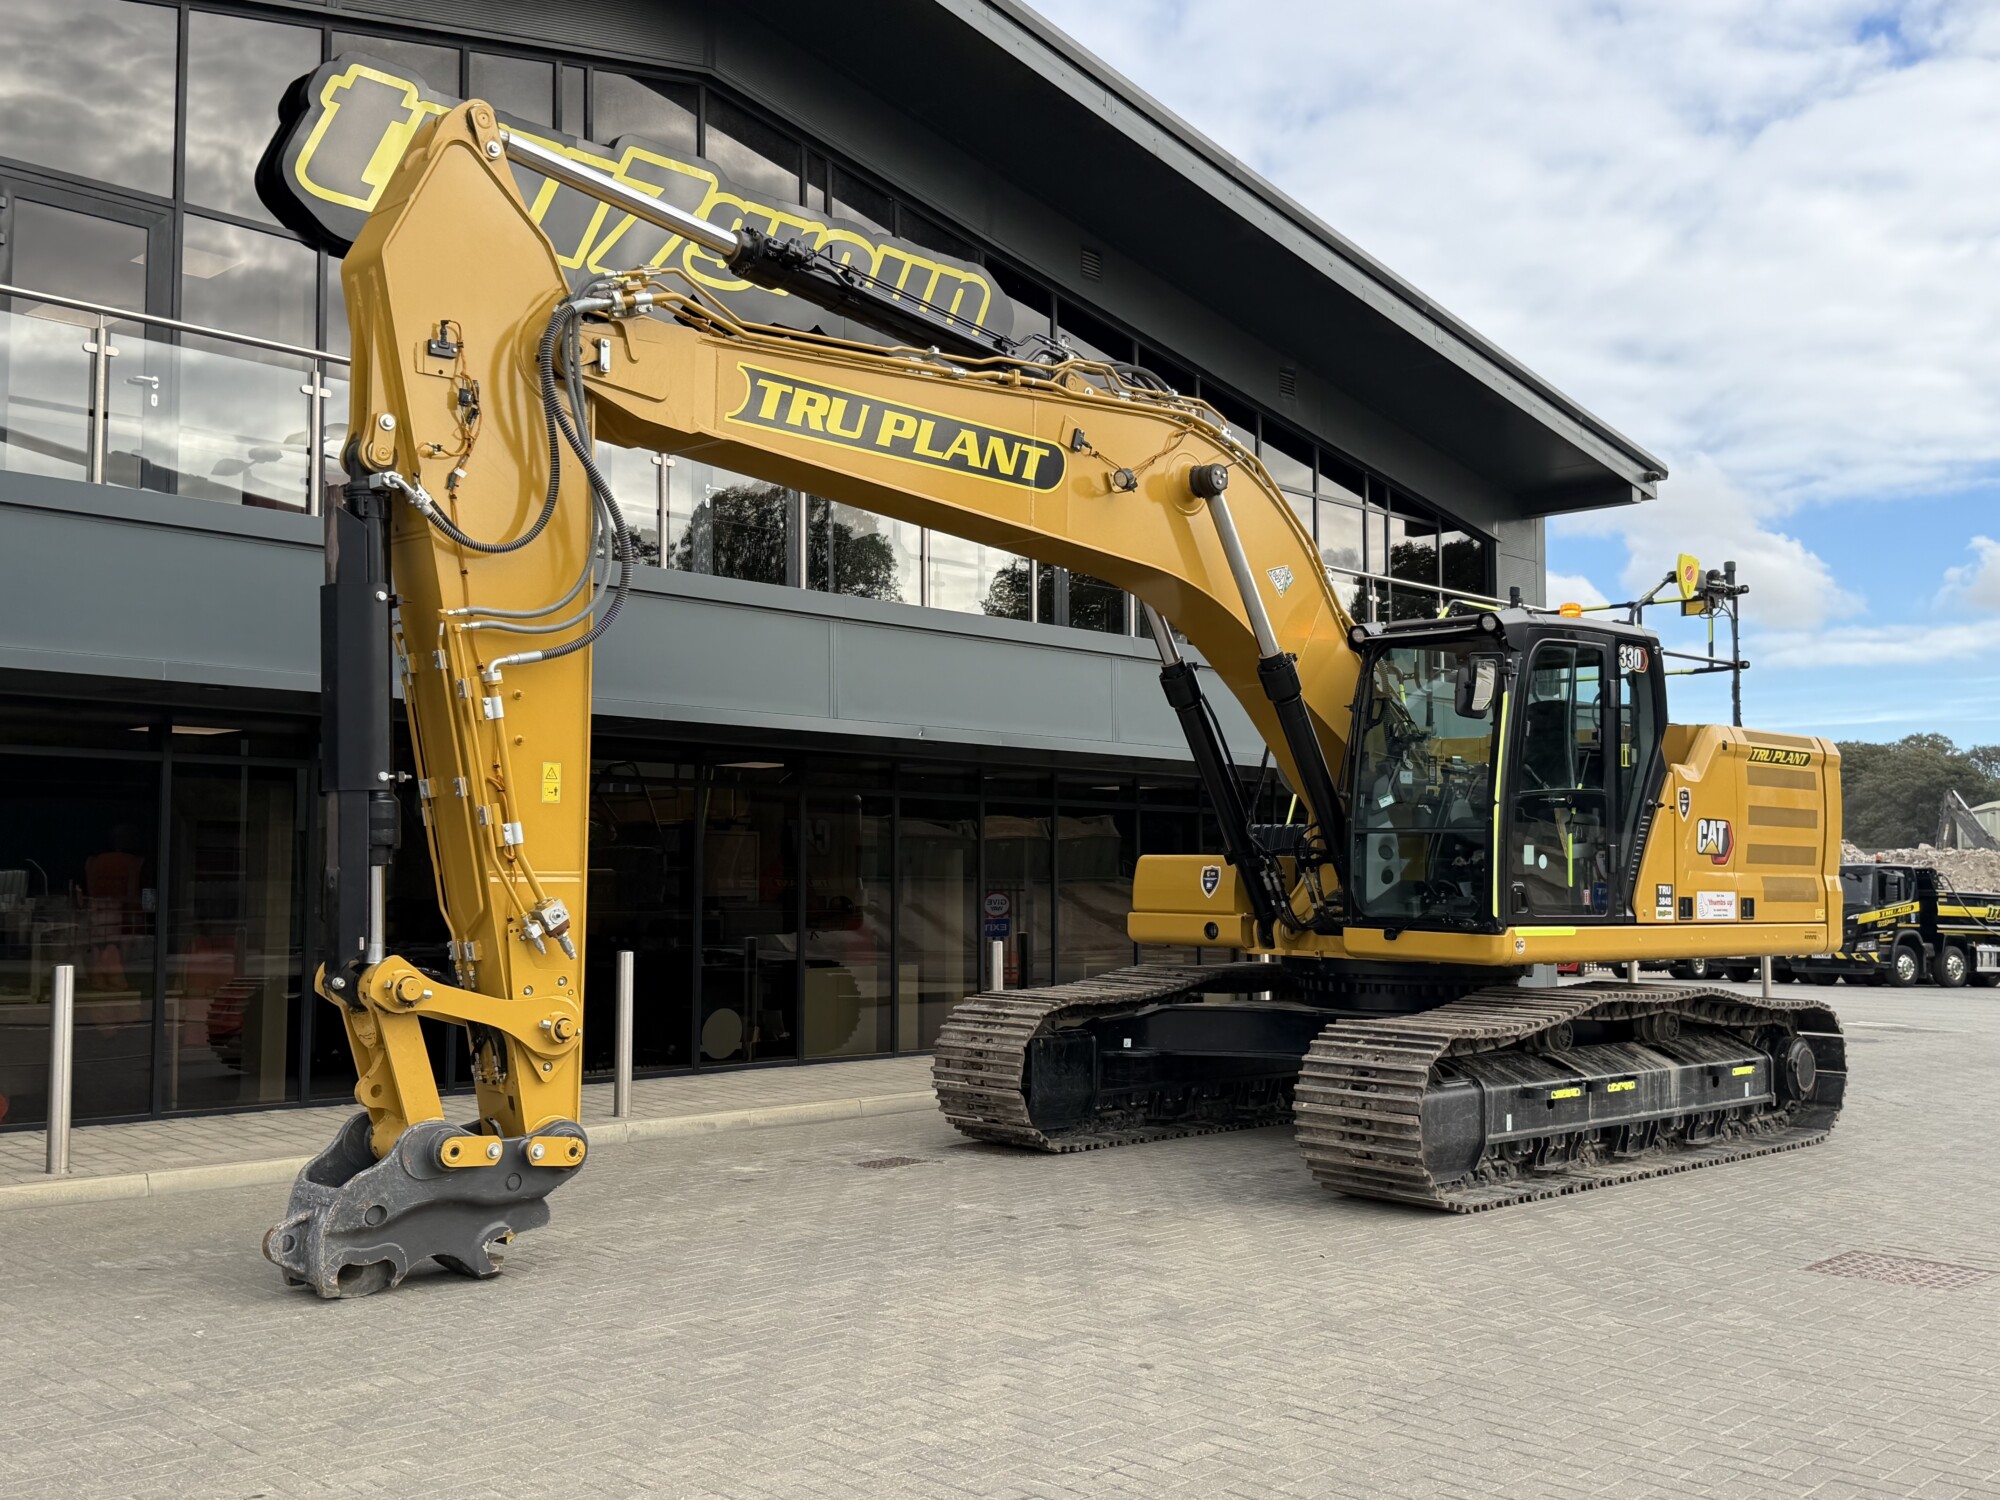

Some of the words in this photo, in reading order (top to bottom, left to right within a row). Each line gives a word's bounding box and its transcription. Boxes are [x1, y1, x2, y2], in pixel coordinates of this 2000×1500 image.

[757, 378, 871, 440] TRU
[875, 409, 1050, 481] PLANT
[1620, 645, 1641, 670] 330
[1751, 748, 1774, 762] TRU
[1771, 750, 1809, 765] PLANT
[1697, 818, 1728, 855] CAT
[1658, 885, 1671, 895] TRU
